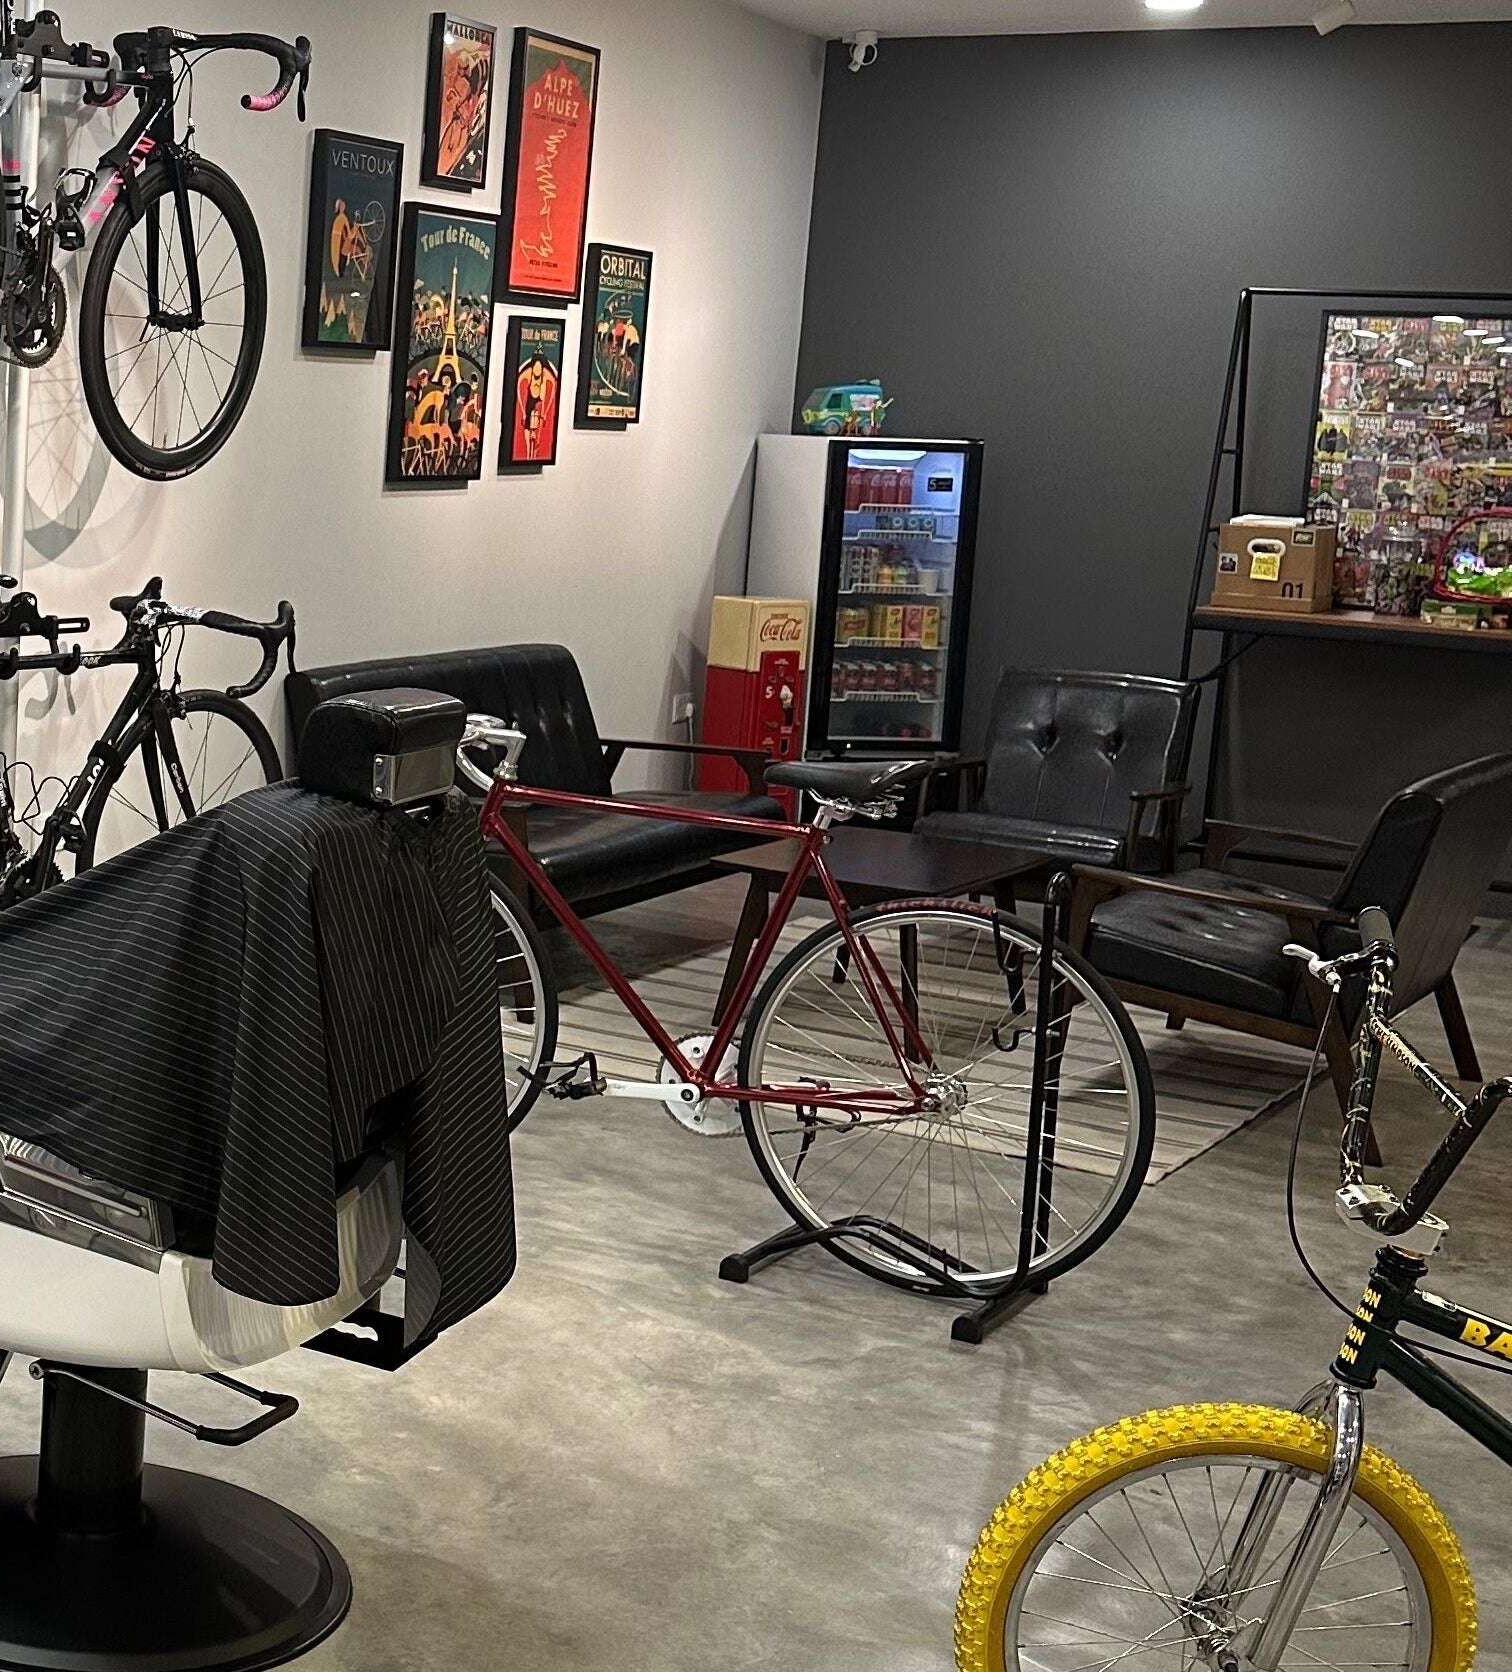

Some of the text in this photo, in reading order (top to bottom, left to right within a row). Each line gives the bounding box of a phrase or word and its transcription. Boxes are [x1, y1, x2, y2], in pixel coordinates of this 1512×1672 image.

[544, 74, 573, 97] ALPE
[533, 92, 580, 119] D'HUEZ
[332, 149, 396, 177] VENTOUX
[420, 224, 491, 261] Tour de France
[600, 255, 647, 280] ORBITAL
[1281, 582, 1304, 599] 01
[170, 762, 184, 794] Carbon
